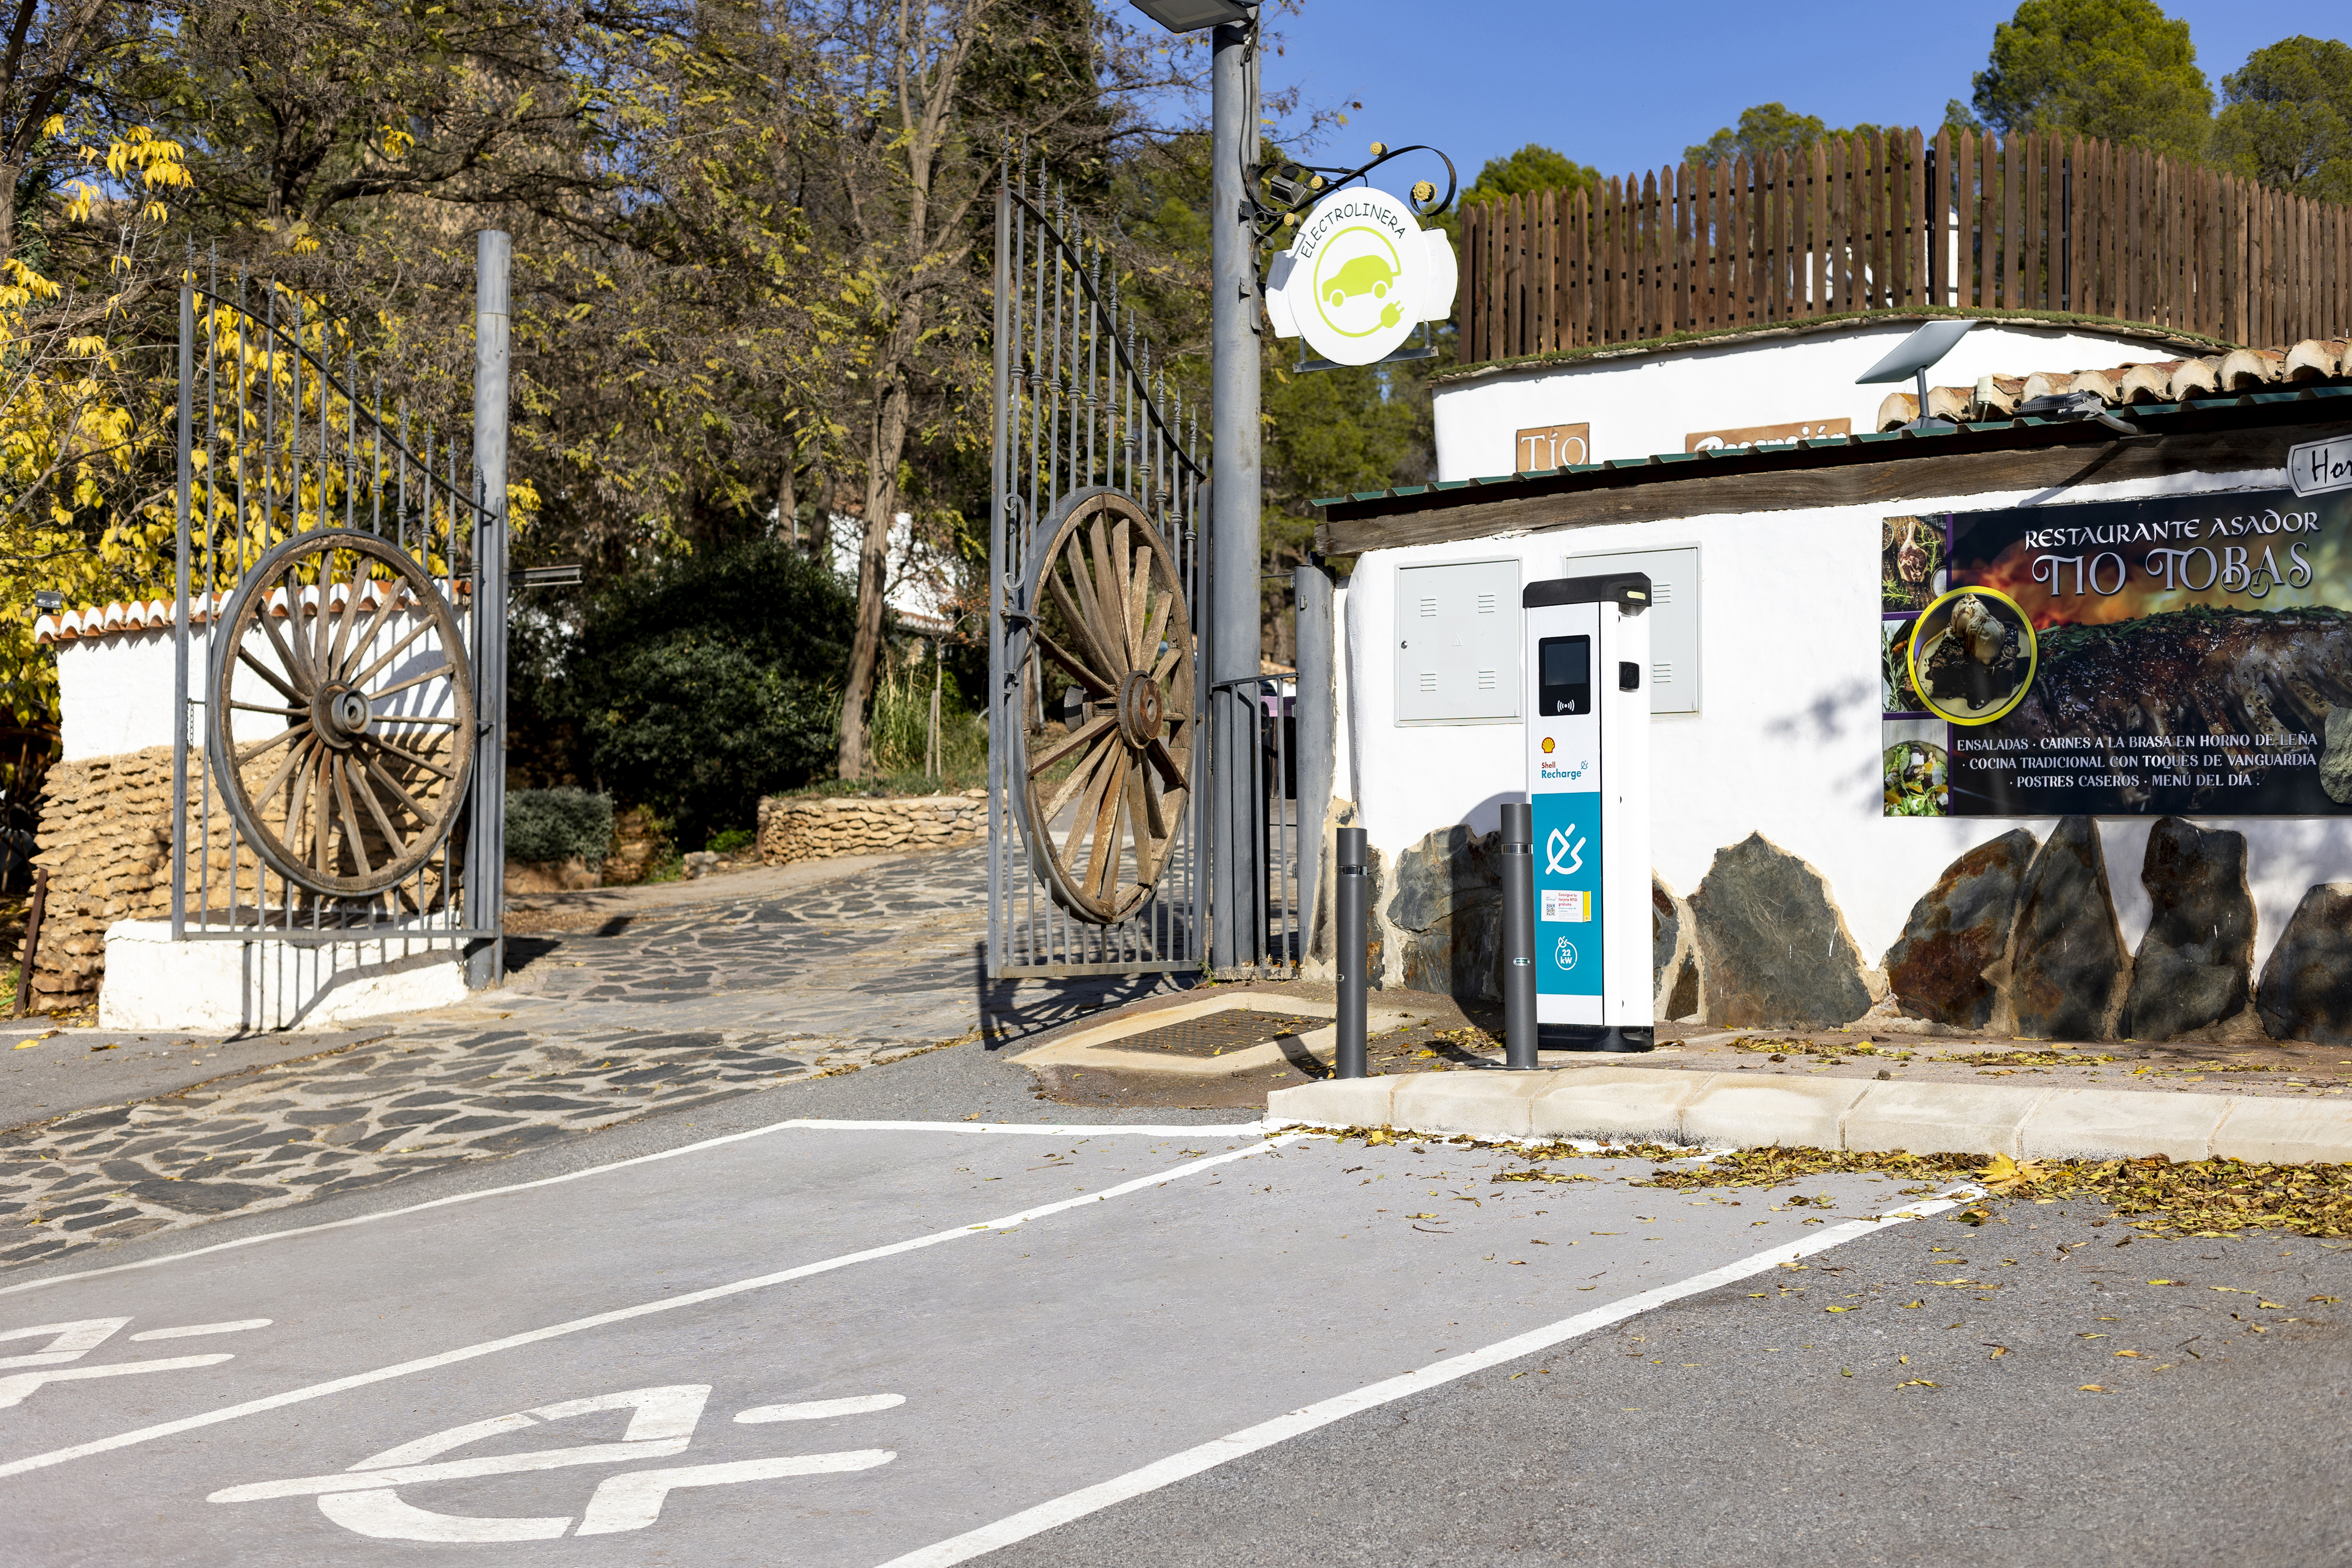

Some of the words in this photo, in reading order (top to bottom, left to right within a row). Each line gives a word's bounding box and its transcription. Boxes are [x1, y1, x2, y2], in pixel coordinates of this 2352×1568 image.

[1300, 202, 1406, 258] ELECTROLINERA
[1520, 431, 1587, 472] TÍO
[2024, 518, 2200, 551] RESTAURANTE
[2208, 508, 2321, 539] ASADOR
[2032, 551, 2127, 597] TIO
[2145, 542, 2312, 597] TOBAS
[1957, 738, 2029, 751] ENSALADAS
[2040, 737, 2091, 750] CARNES
[2095, 736, 2104, 748] A
[2108, 736, 2124, 748] LA
[2129, 735, 2172, 748] BRASA
[2176, 735, 2195, 747] EN
[2200, 734, 2250, 747] HORNO
[2255, 734, 2275, 746] DE
[2280, 731, 2318, 746] LEÑA
[1969, 757, 2017, 769] COCINA
[2020, 756, 2105, 769] TRADICIONAL
[2109, 755, 2138, 768] CON
[2142, 754, 2199, 769] TOQUES
[2204, 754, 2222, 767] DE
[2227, 753, 2317, 766] VANGUARDIA
[1541, 768, 1582, 780] Recharge
[2017, 775, 2074, 788] POSTRES
[2078, 775, 2140, 787] CASEROS
[2152, 772, 2191, 787] MENÚ
[2196, 774, 2224, 786] DEL
[1560, 956, 1573, 964] kW
